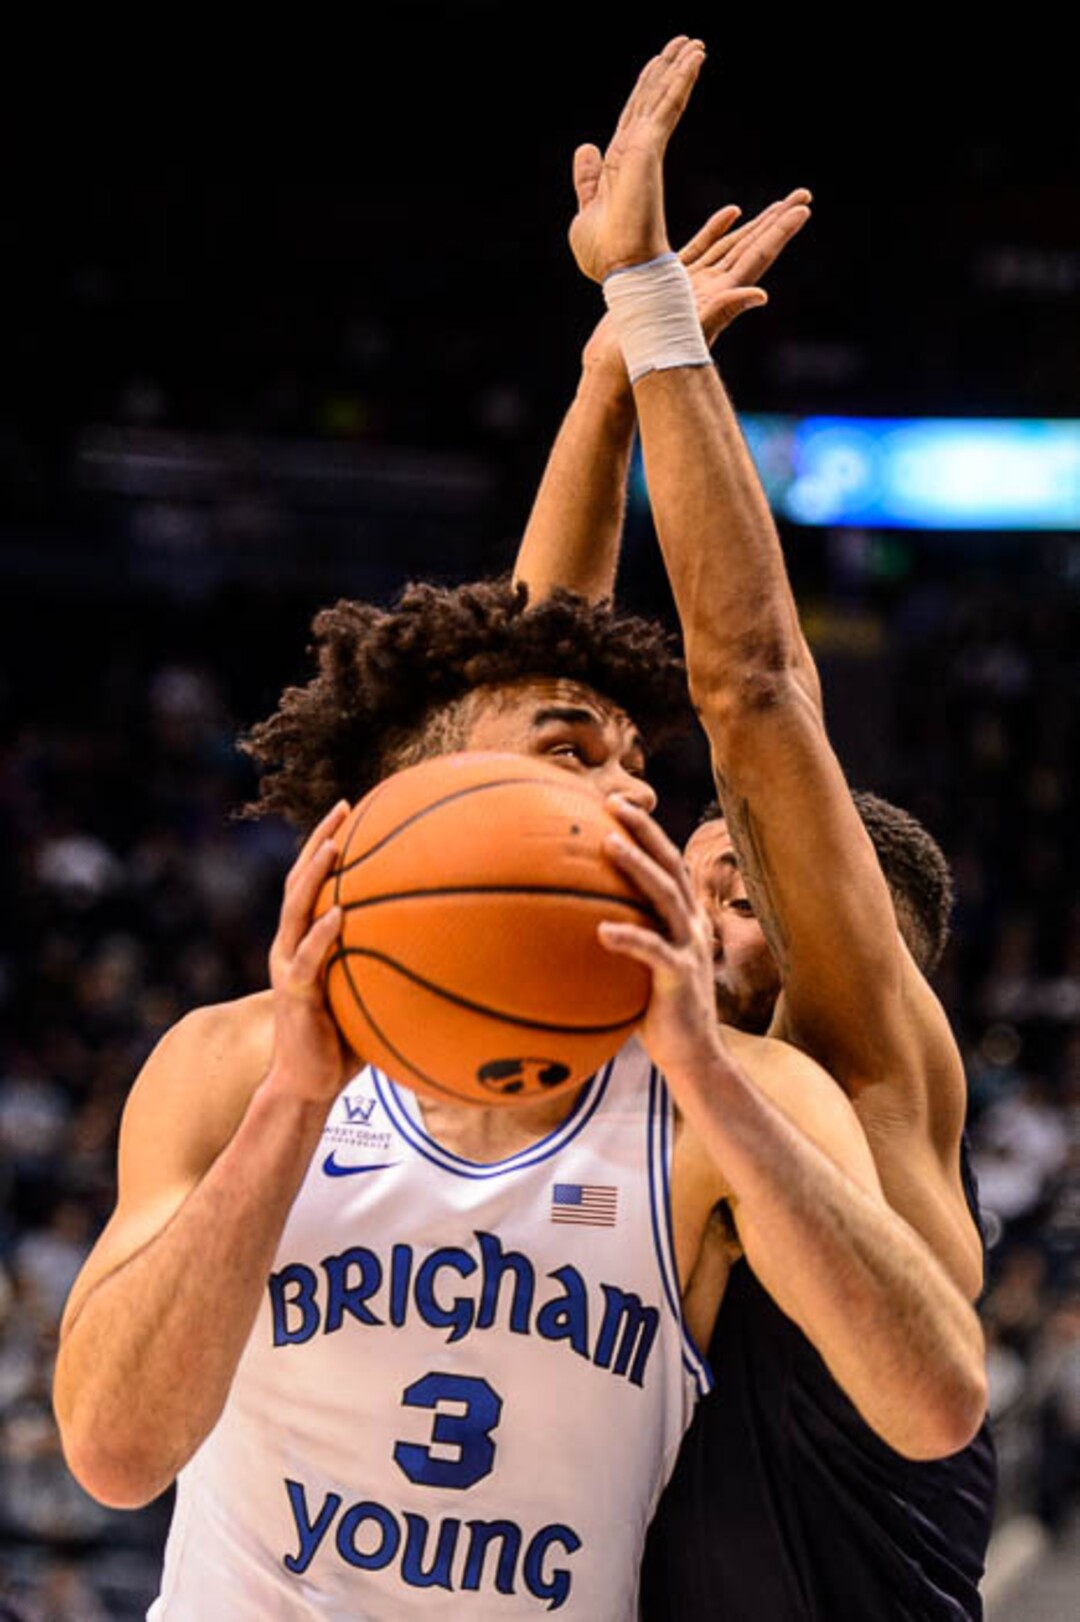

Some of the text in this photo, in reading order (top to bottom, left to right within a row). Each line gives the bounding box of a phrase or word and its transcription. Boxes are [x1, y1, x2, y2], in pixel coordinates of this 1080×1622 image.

[342, 1096, 377, 1121] W
[356, 1130, 391, 1141] COAST
[393, 1371, 503, 1490] 3
